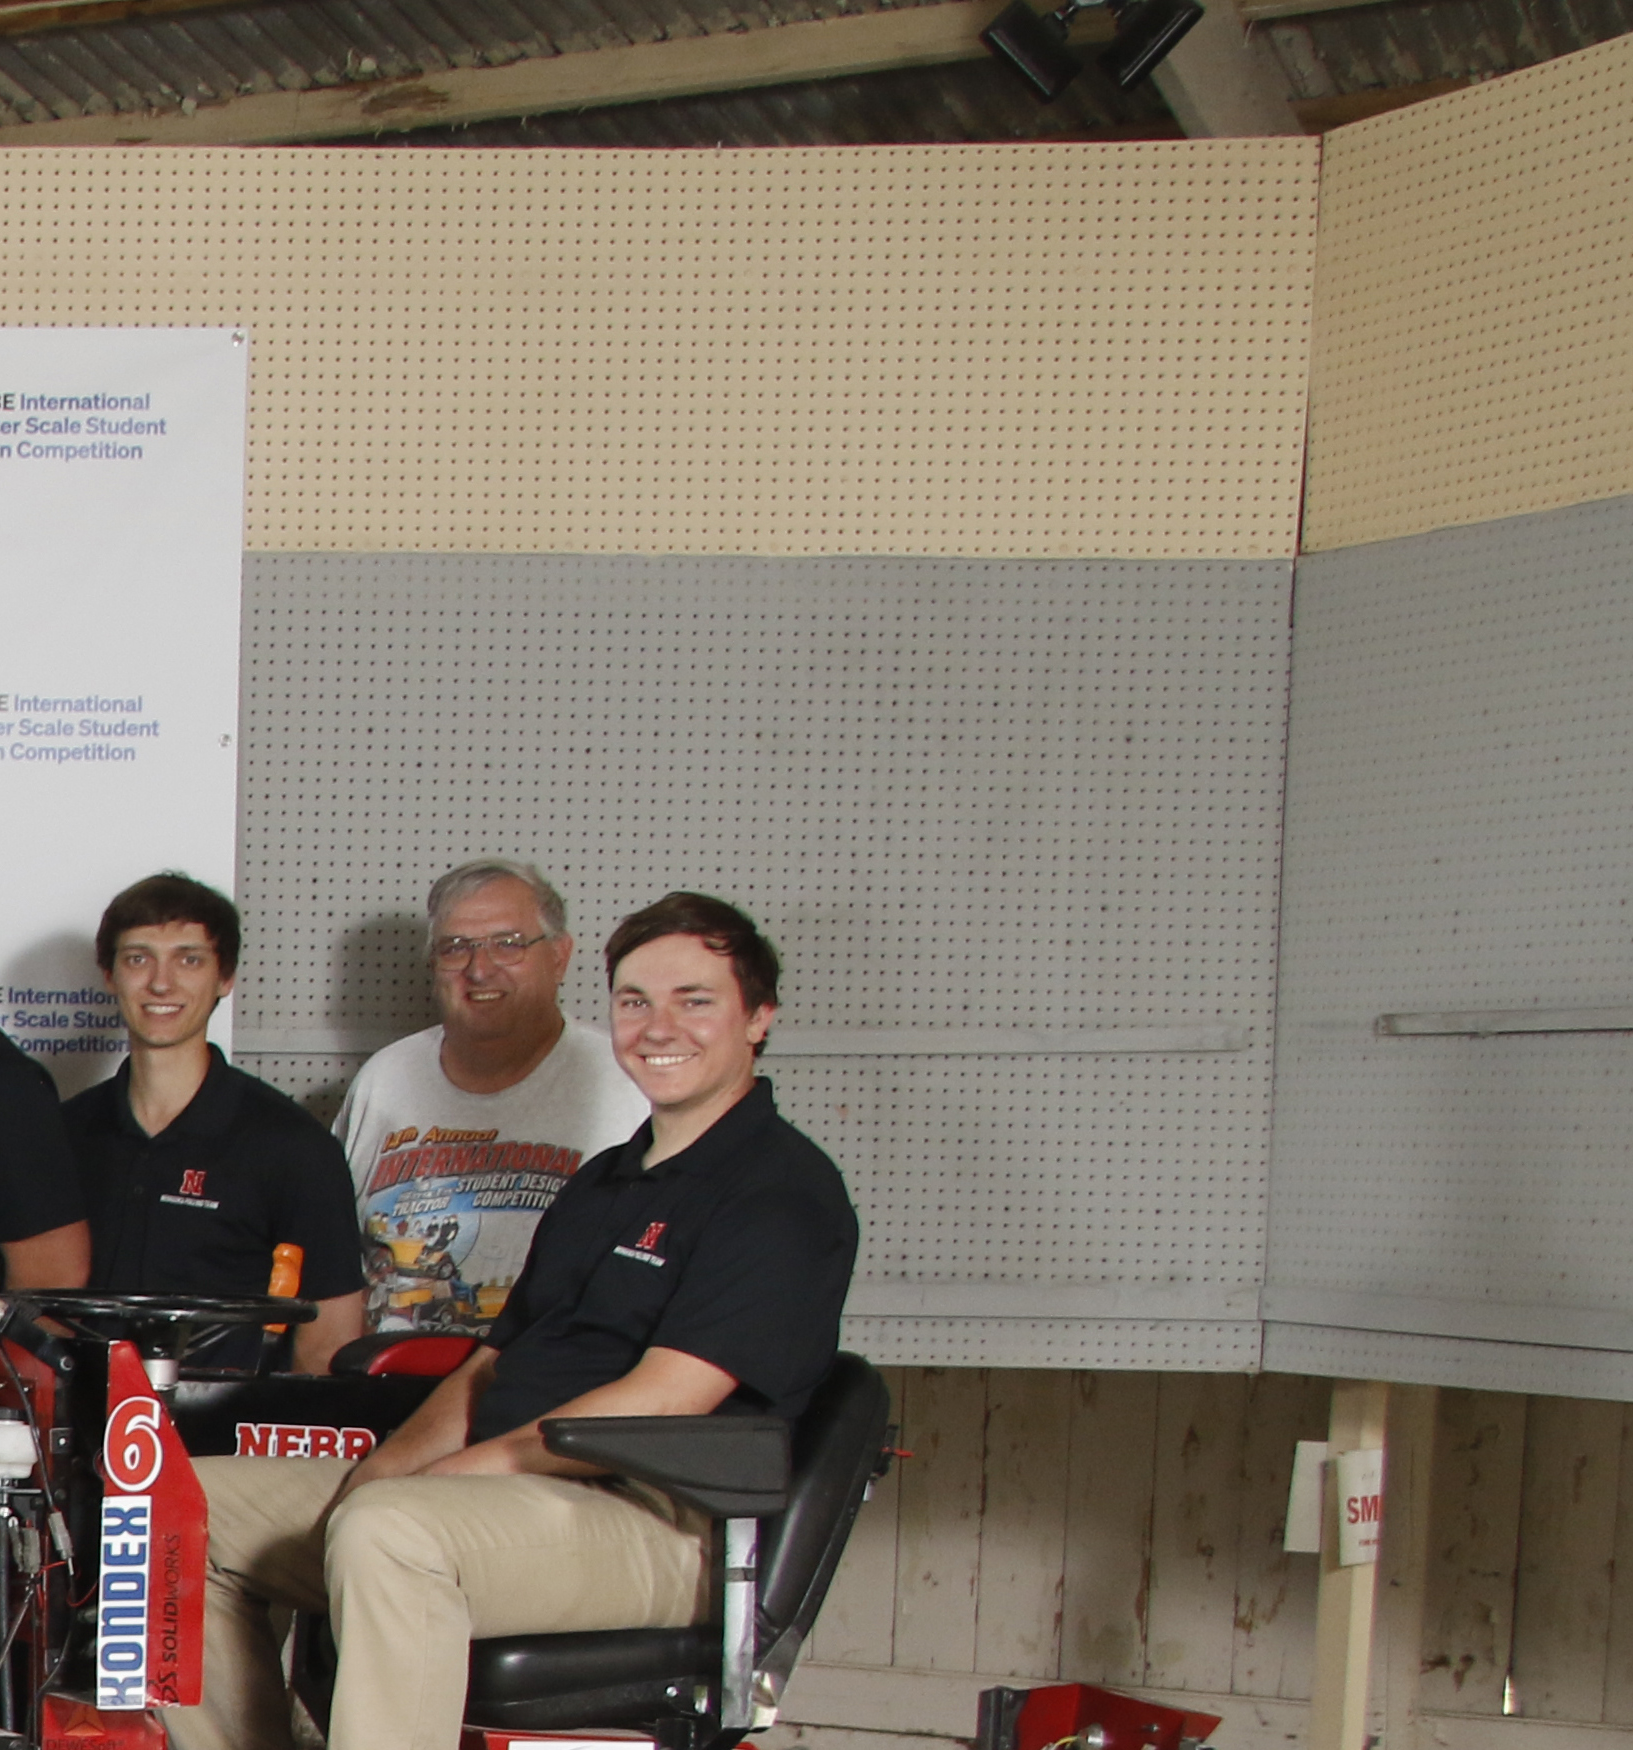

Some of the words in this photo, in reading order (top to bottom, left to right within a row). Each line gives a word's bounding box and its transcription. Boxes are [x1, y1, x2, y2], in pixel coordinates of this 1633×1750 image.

[21, 393, 150, 410] International
[25, 417, 81, 434] Scale
[86, 417, 166, 435] Student
[17, 441, 142, 462] Competition
[15, 695, 142, 712] International
[19, 719, 73, 735] Scale
[79, 719, 159, 736] Student
[10, 743, 135, 764] Competition
[8, 986, 119, 1005] Internation
[13, 1010, 70, 1029] Scale
[420, 1126, 499, 1144] Annual
[367, 1141, 583, 1197] INTERNATIONAL
[456, 1174, 517, 1193] STUDENT
[518, 1173, 566, 1193] DESIG
[472, 1190, 556, 1210] COMPETITIO
[104, 1396, 163, 1492] 6
[99, 1506, 149, 1708] KONDEX
[162, 1533, 180, 1663] SOLIDWORKS
